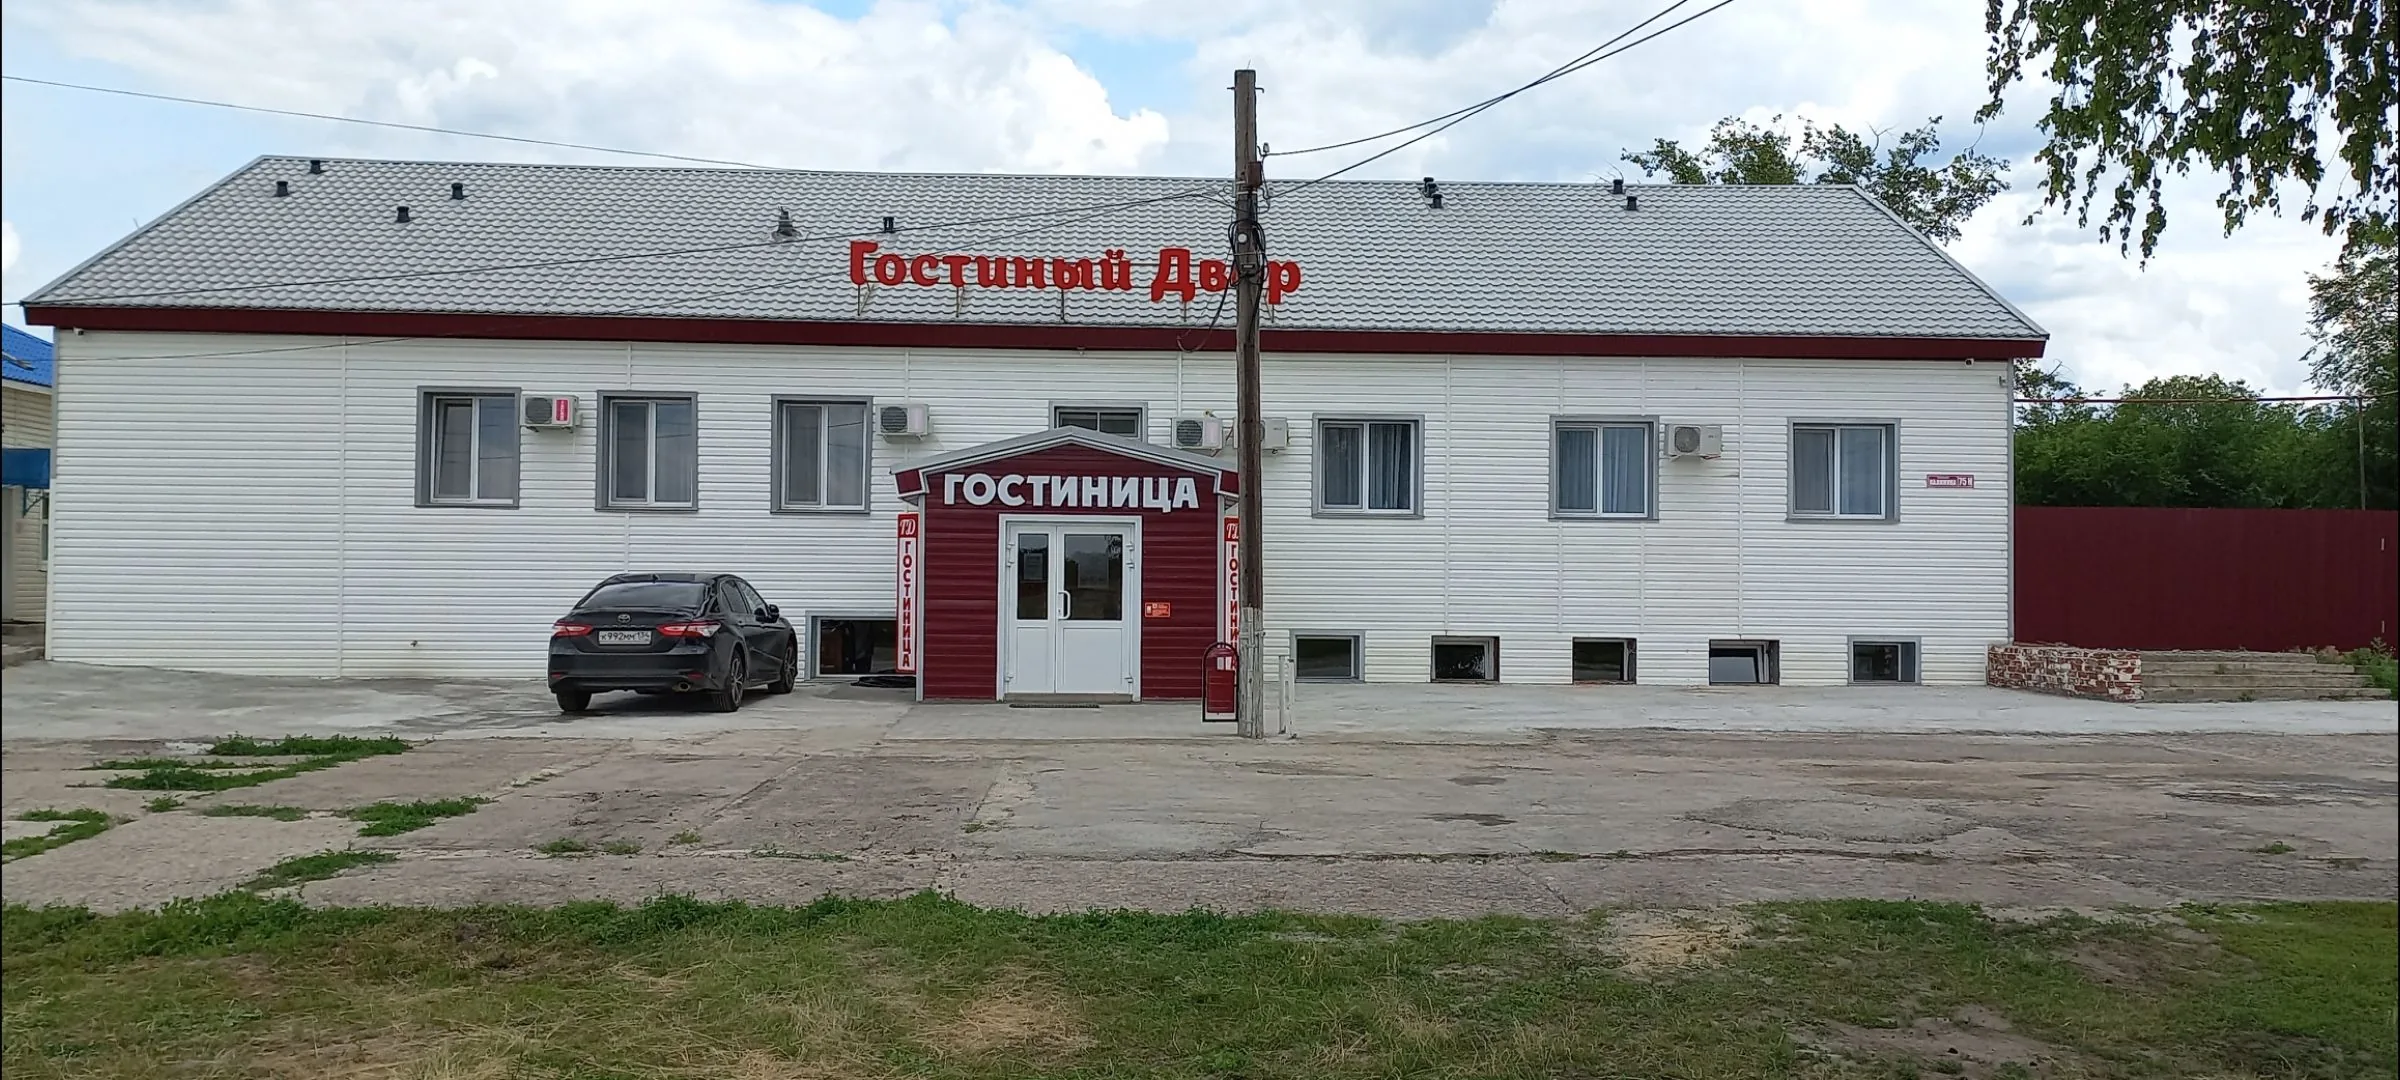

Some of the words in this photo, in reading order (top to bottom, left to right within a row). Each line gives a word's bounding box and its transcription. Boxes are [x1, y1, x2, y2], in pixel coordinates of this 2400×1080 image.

[850, 241, 1132, 290] Гостиный
[1151, 248, 1301, 304] Двр
[944, 473, 1199, 512] ГОСТИНИЦА
[902, 541, 912, 667] ГОСТИНИЦА
